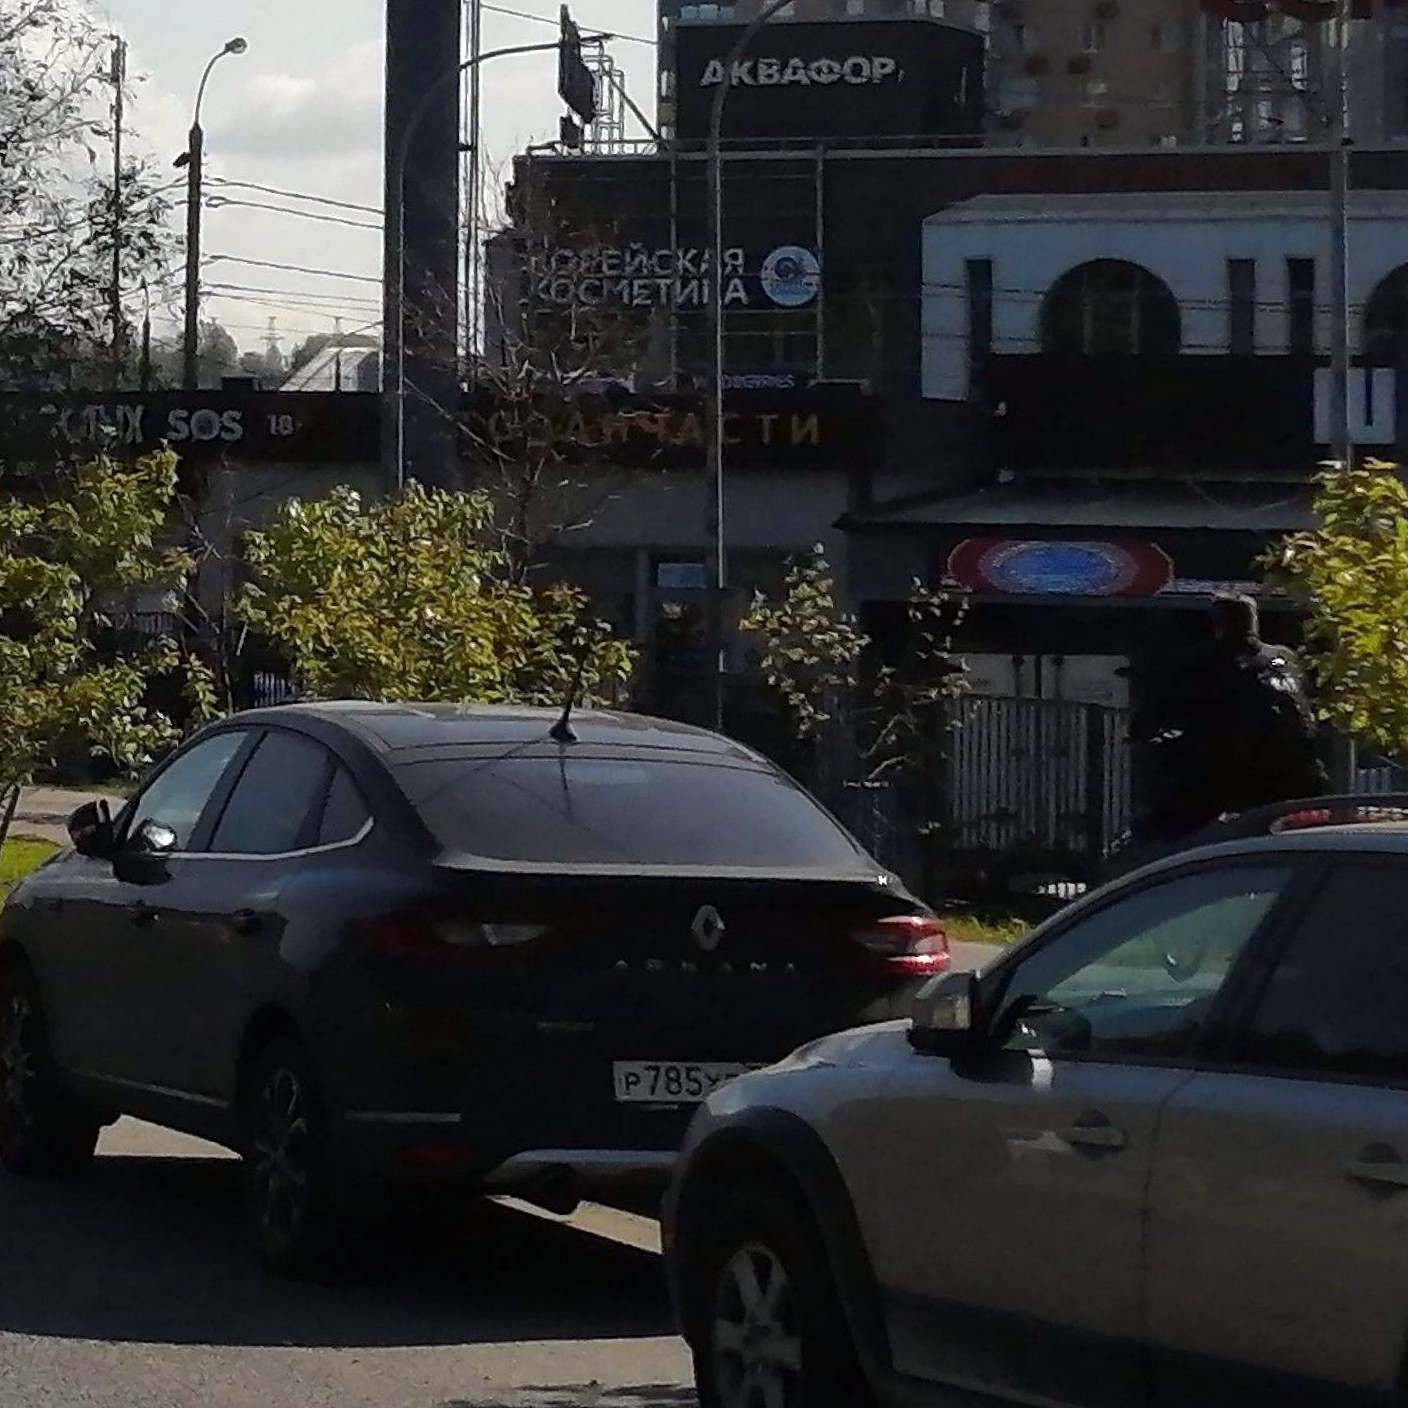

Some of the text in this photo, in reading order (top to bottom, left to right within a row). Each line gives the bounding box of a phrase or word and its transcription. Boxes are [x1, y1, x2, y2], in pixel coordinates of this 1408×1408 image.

[700, 56, 896, 86] АКВАФОР
[530, 244, 745, 276] ОЕЙСКАЯ
[167, 407, 244, 442] SOS
